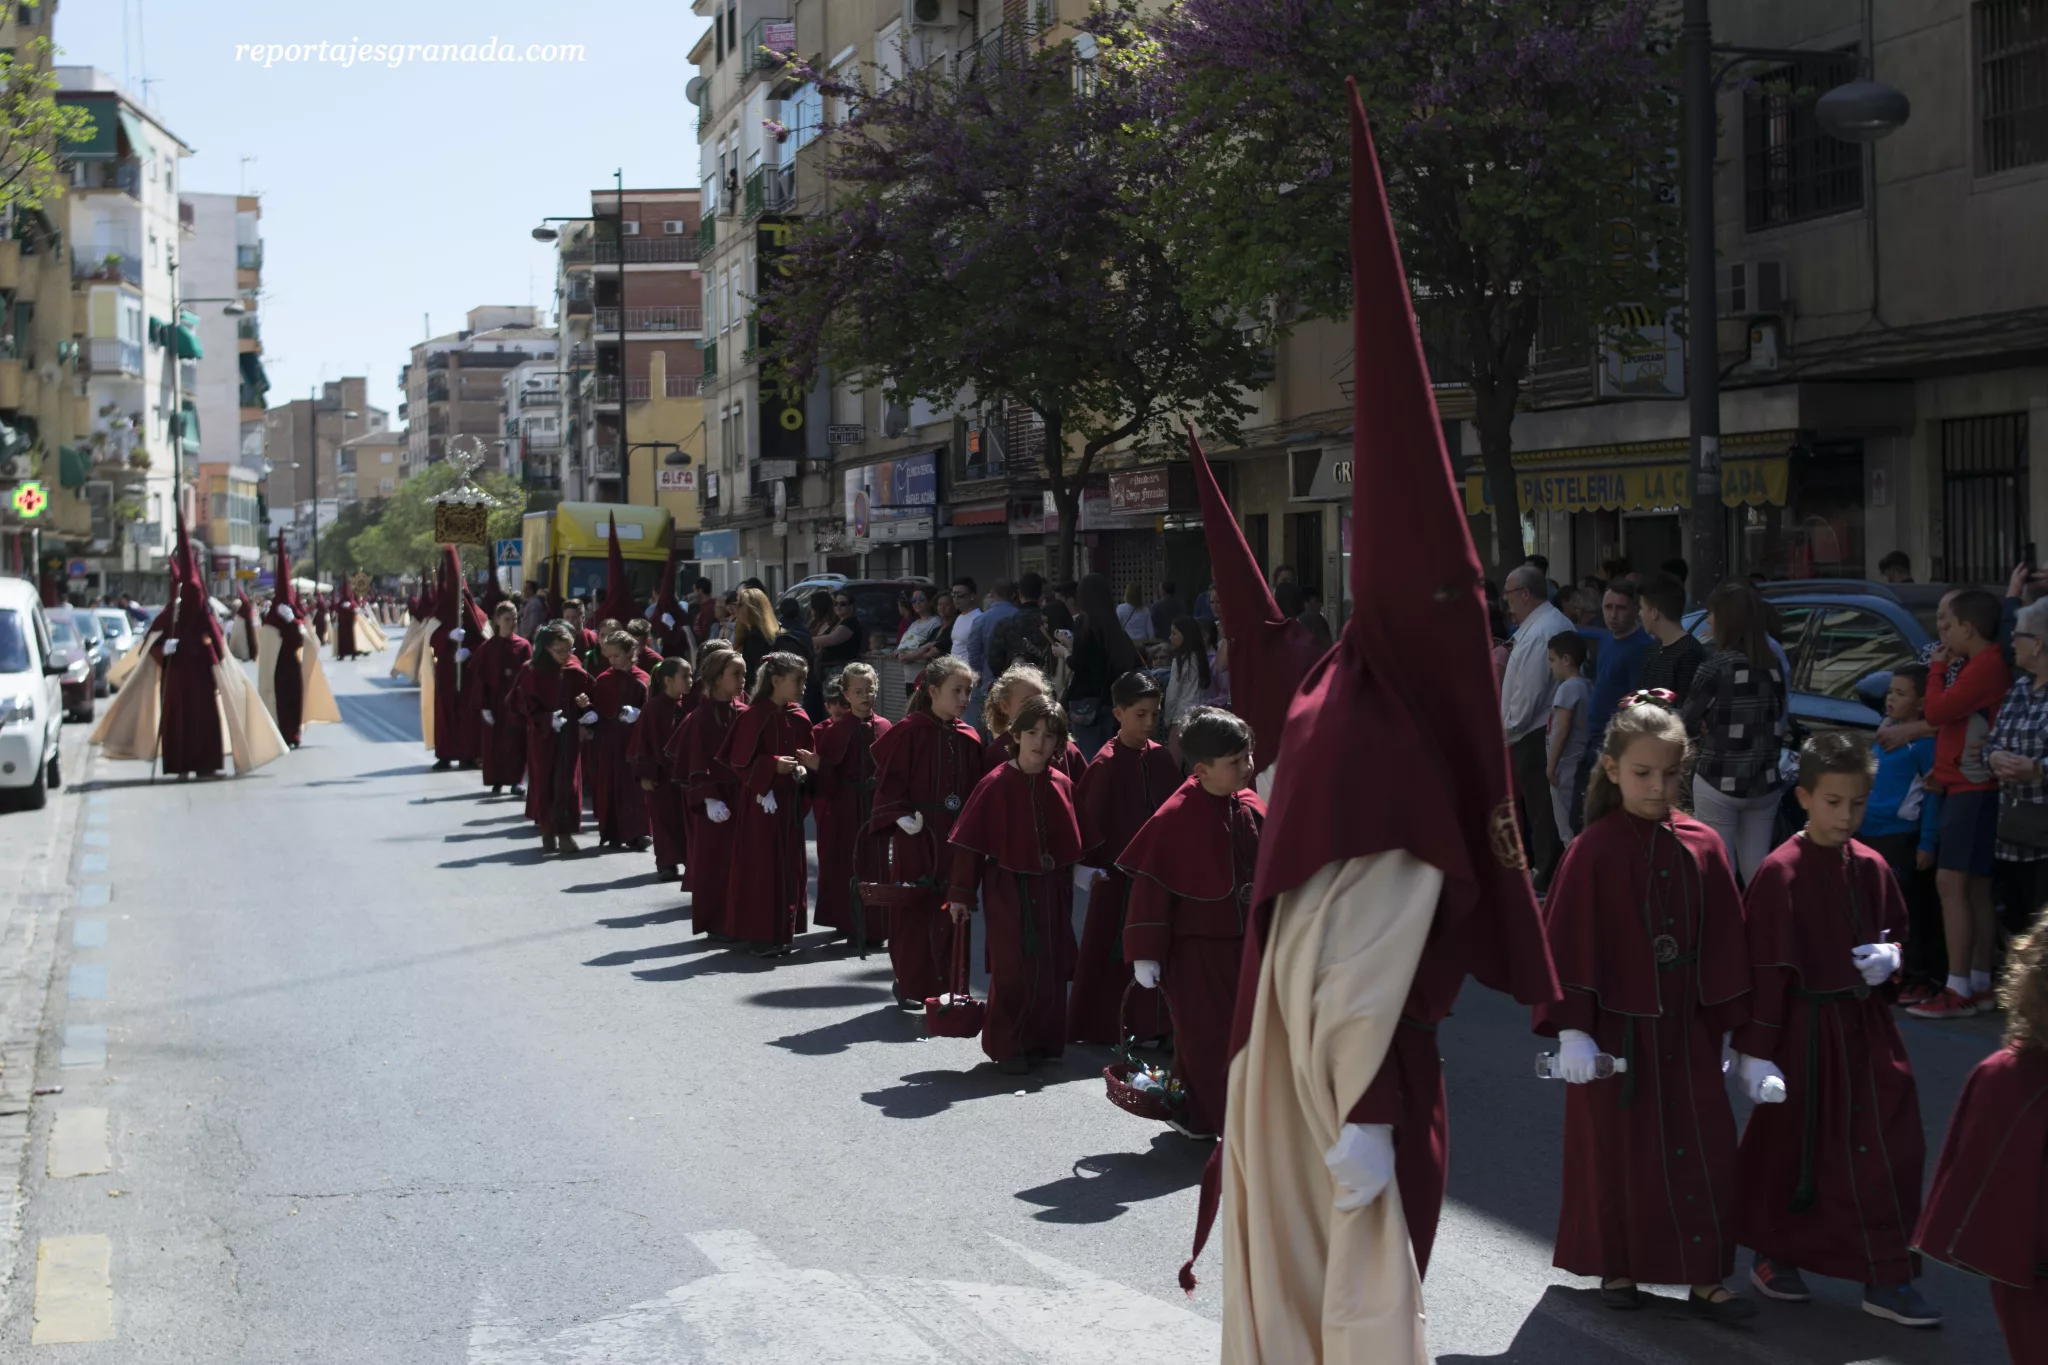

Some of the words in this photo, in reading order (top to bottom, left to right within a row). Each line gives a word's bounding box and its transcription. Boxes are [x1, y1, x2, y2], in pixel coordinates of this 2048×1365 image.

[1523, 474, 1625, 504] PASTELERIA
[1644, 472, 1665, 499] LA
[1673, 466, 1767, 498] CADA
